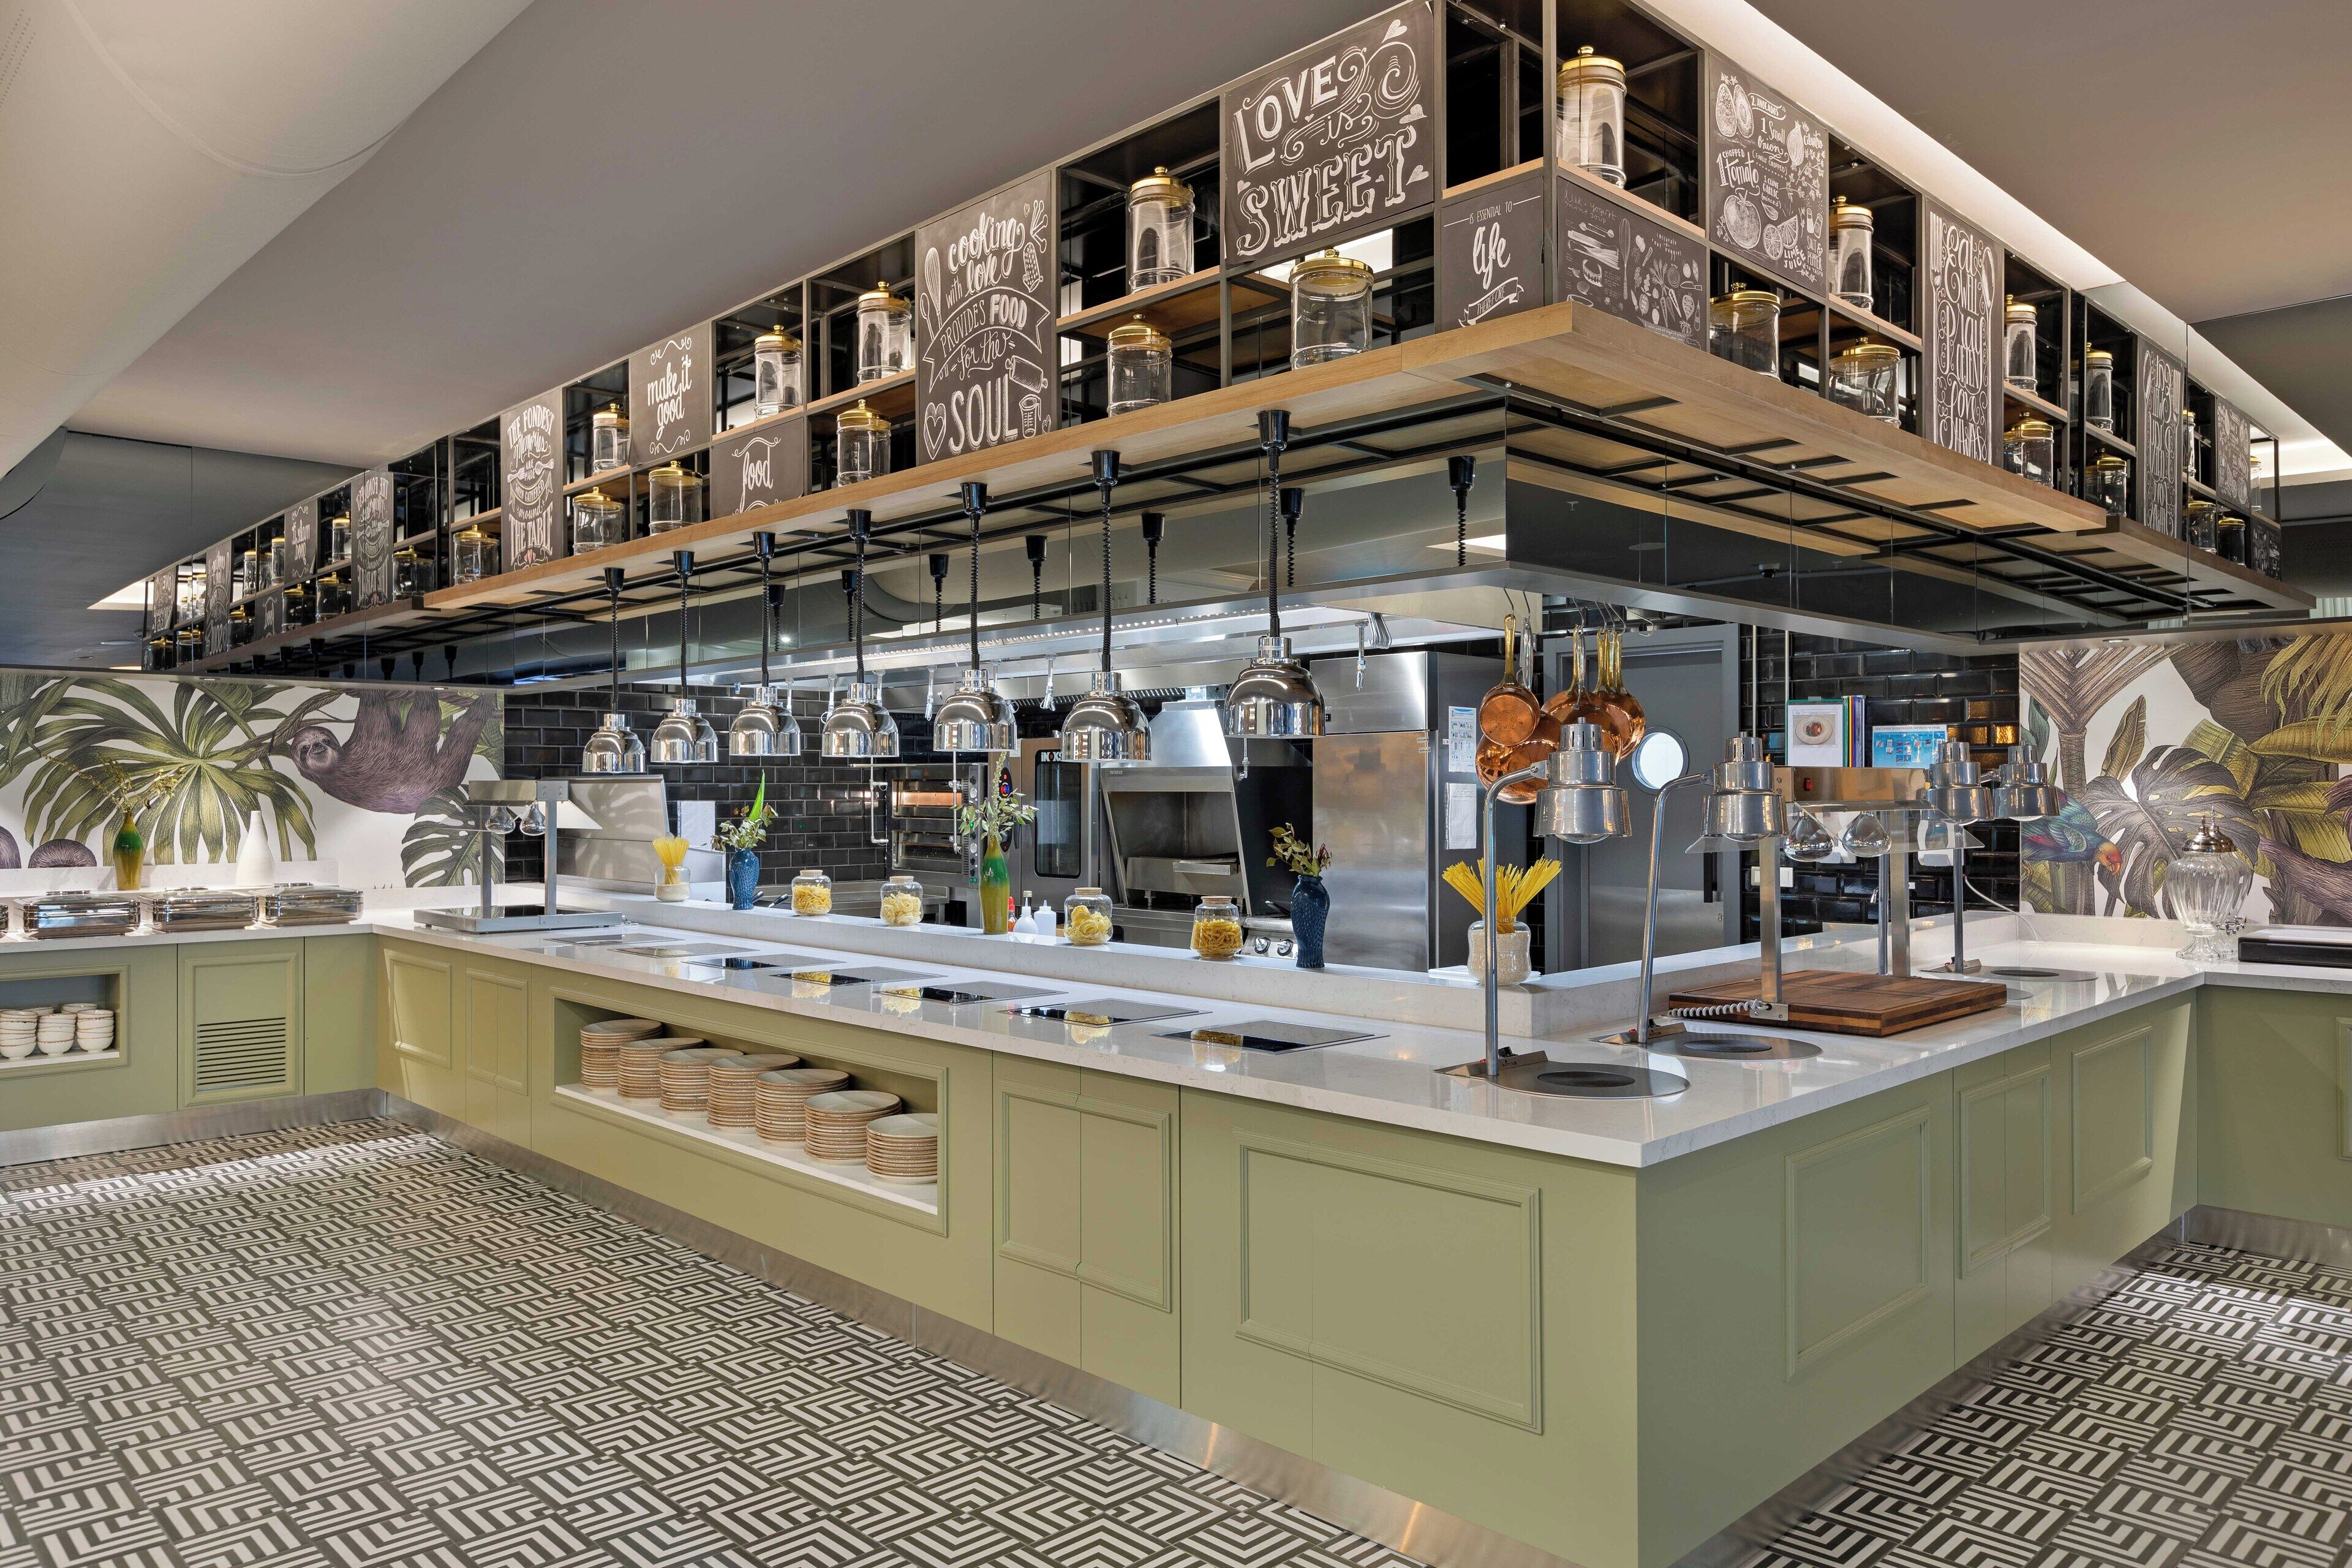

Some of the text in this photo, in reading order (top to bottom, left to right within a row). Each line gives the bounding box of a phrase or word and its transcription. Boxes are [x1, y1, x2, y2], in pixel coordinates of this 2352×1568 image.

[1232, 54, 1340, 175] LOVE
[1751, 96, 1779, 117] 2 AVOCADOS
[1761, 117, 1785, 145] 1 Small
[1722, 148, 1745, 159] CHOPPED
[1768, 160, 1787, 176] CHOPPED)
[1716, 153, 1729, 187] 1
[1764, 175, 1767, 183] 1
[1236, 124, 1417, 257] SWEET
[1761, 192, 1782, 209] (minced)
[1762, 183, 1779, 200] GARLIC
[1469, 200, 1513, 224] IS ESSENTIAL TO
[948, 212, 1025, 279] cooking
[1472, 222, 1511, 291] life
[1784, 244, 1800, 259] LIME
[1784, 249, 1806, 270] JUICE
[1807, 235, 1824, 257] SALT &
[1807, 251, 1822, 271] PEPPER
[1812, 268, 1823, 277] TASTE
[945, 252, 1001, 309] with love
[1959, 269, 1979, 316] WELL
[1477, 285, 1506, 315] THEREFORE
[940, 293, 1028, 358] PROVIDES FOOD
[957, 330, 1009, 381] for the
[647, 354, 693, 407] make it
[656, 382, 685, 441] good
[948, 373, 1019, 456] SOUL
[507, 404, 556, 450] THE FONDEST
[513, 428, 549, 468] Memories
[524, 468, 535, 481] MADE
[525, 459, 534, 470] ARE
[524, 479, 545, 503] GATHERED
[739, 446, 774, 513] food
[518, 498, 543, 520] around
[509, 513, 526, 567] THE
